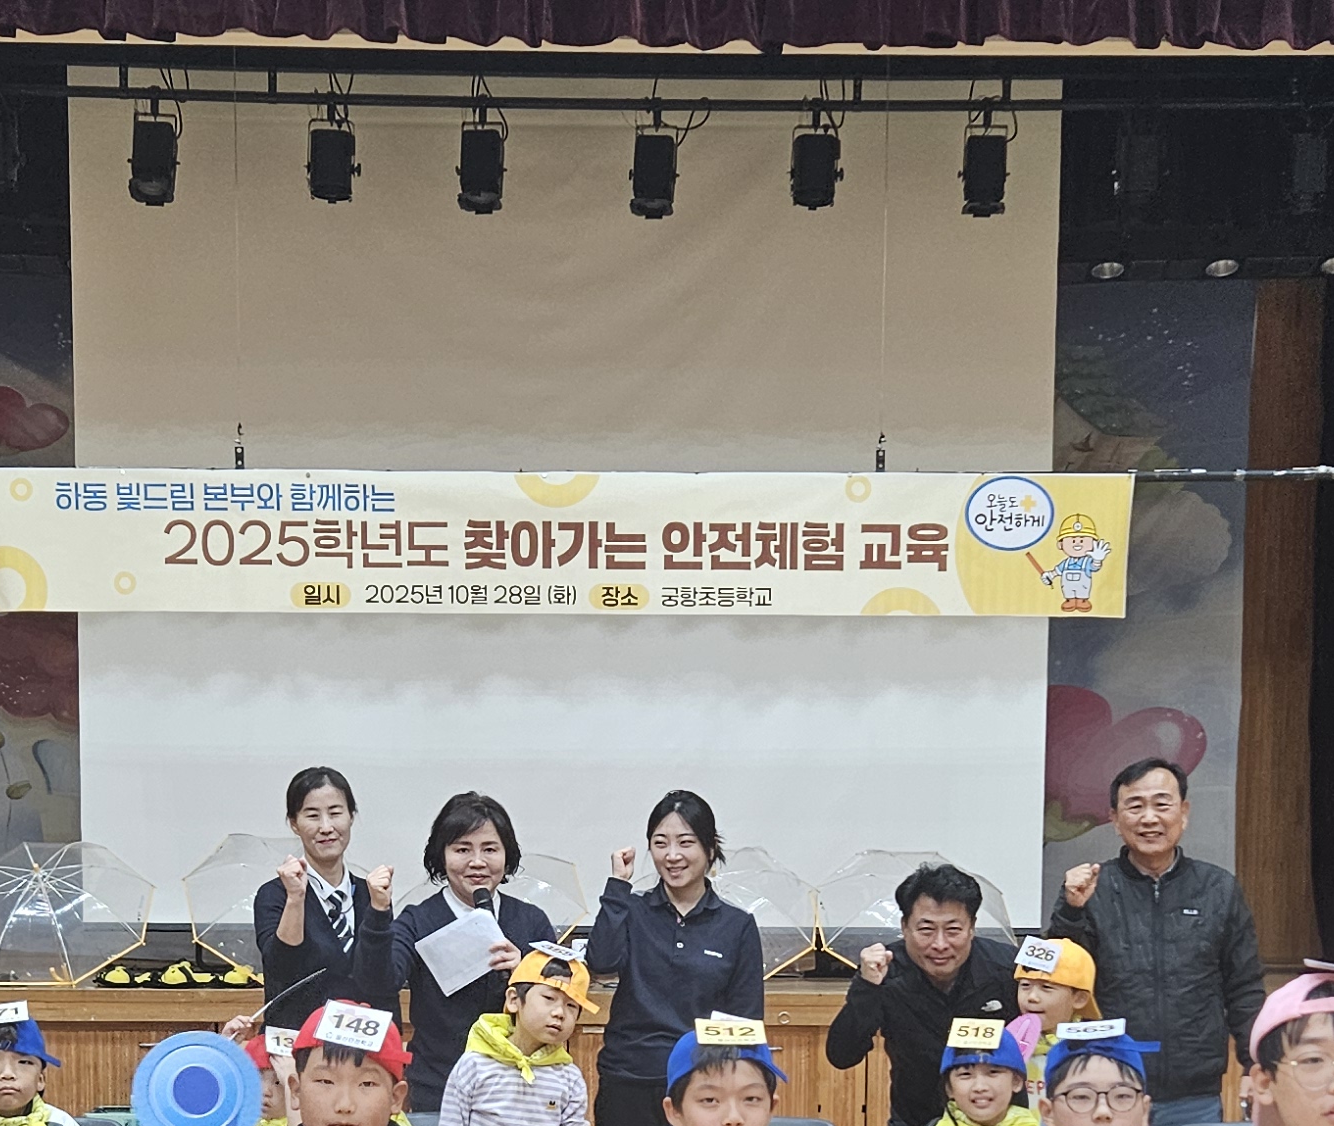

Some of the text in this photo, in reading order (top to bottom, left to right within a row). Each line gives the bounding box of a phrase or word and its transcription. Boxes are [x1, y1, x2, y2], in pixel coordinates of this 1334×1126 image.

[55, 481, 396, 513] 하동 빛드림 본부와 함께하는
[986, 493, 1019, 513] 오늘도
[974, 509, 1045, 532] 안전하게
[163, 518, 949, 572] 2025학년도 찾아가는 안전체험 교육
[303, 584, 773, 608] 일시 2025년 10월 28일 (화) 장소 궁항초등학교
[1024, 945, 1056, 962] 326
[332, 1013, 381, 1037] 148
[704, 1026, 756, 1037] 512
[956, 1025, 996, 1039] 518
